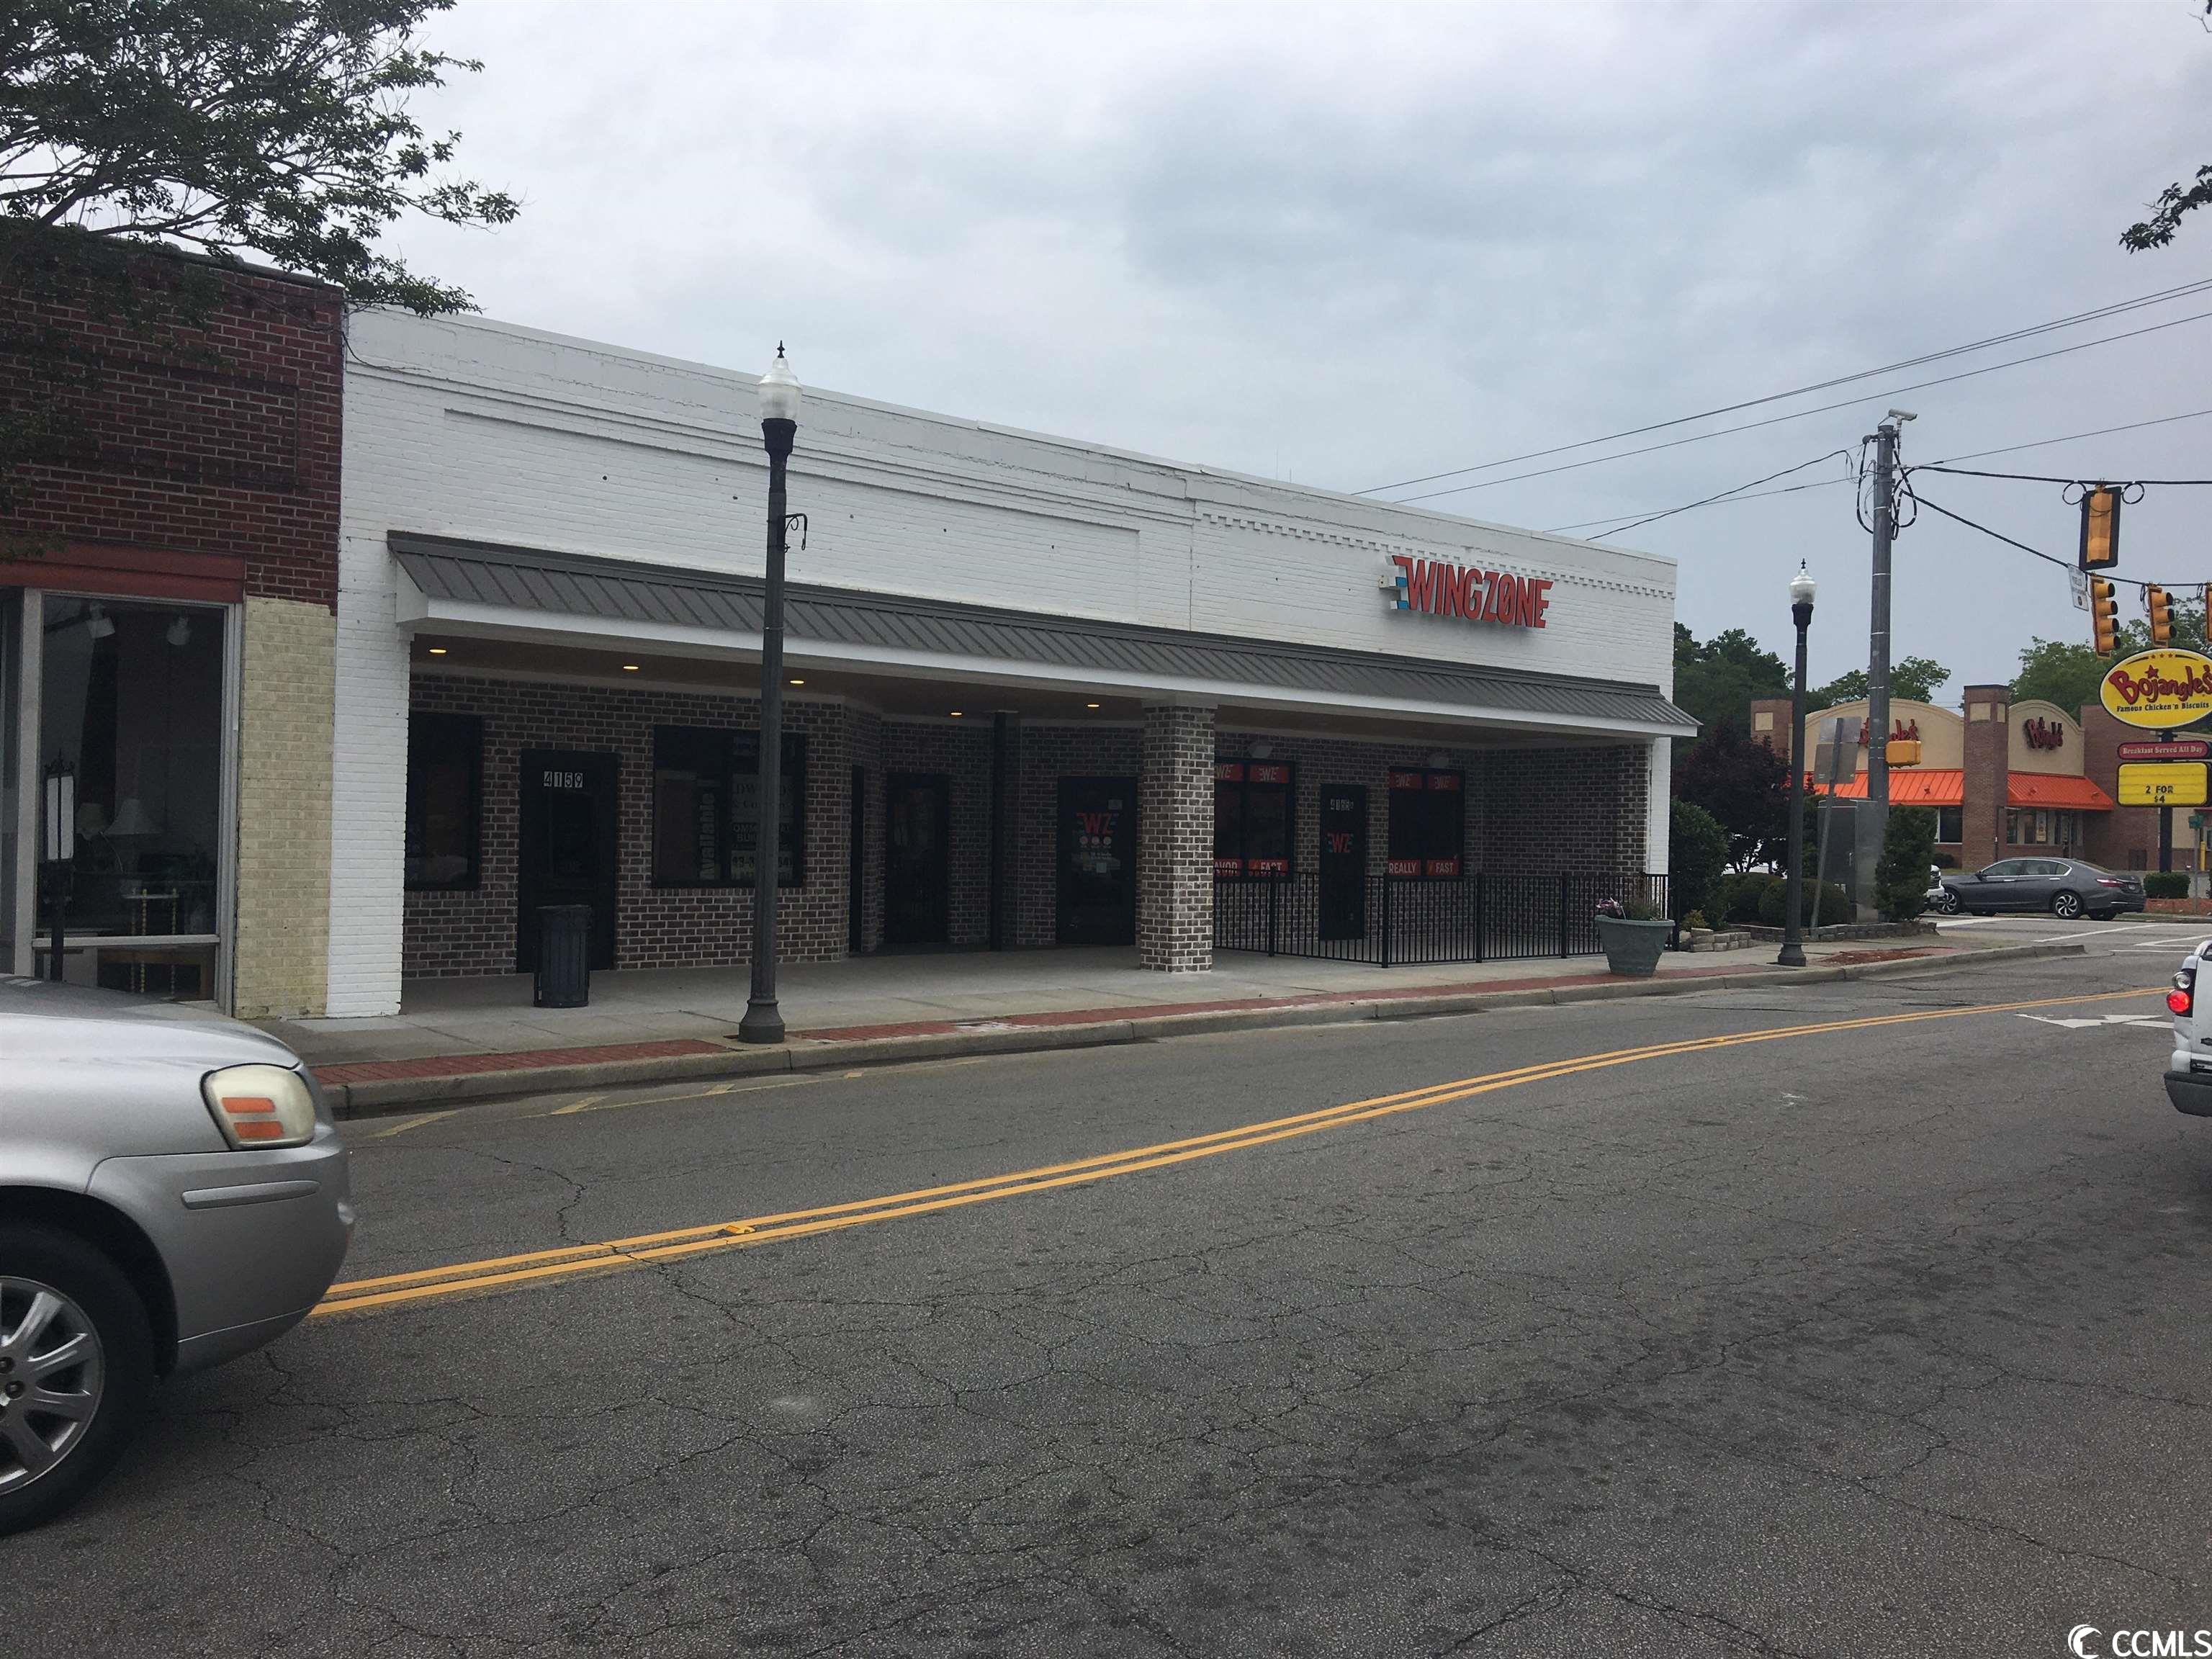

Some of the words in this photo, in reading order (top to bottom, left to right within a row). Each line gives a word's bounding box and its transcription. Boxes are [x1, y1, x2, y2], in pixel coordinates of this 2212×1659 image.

[1392, 555, 1554, 629] WINGZONE
[544, 772, 583, 788] 4159
[2154, 795, 2165, 804] $4
[1388, 862, 1417, 874] REALLY
[1435, 863, 1454, 873] FAST
